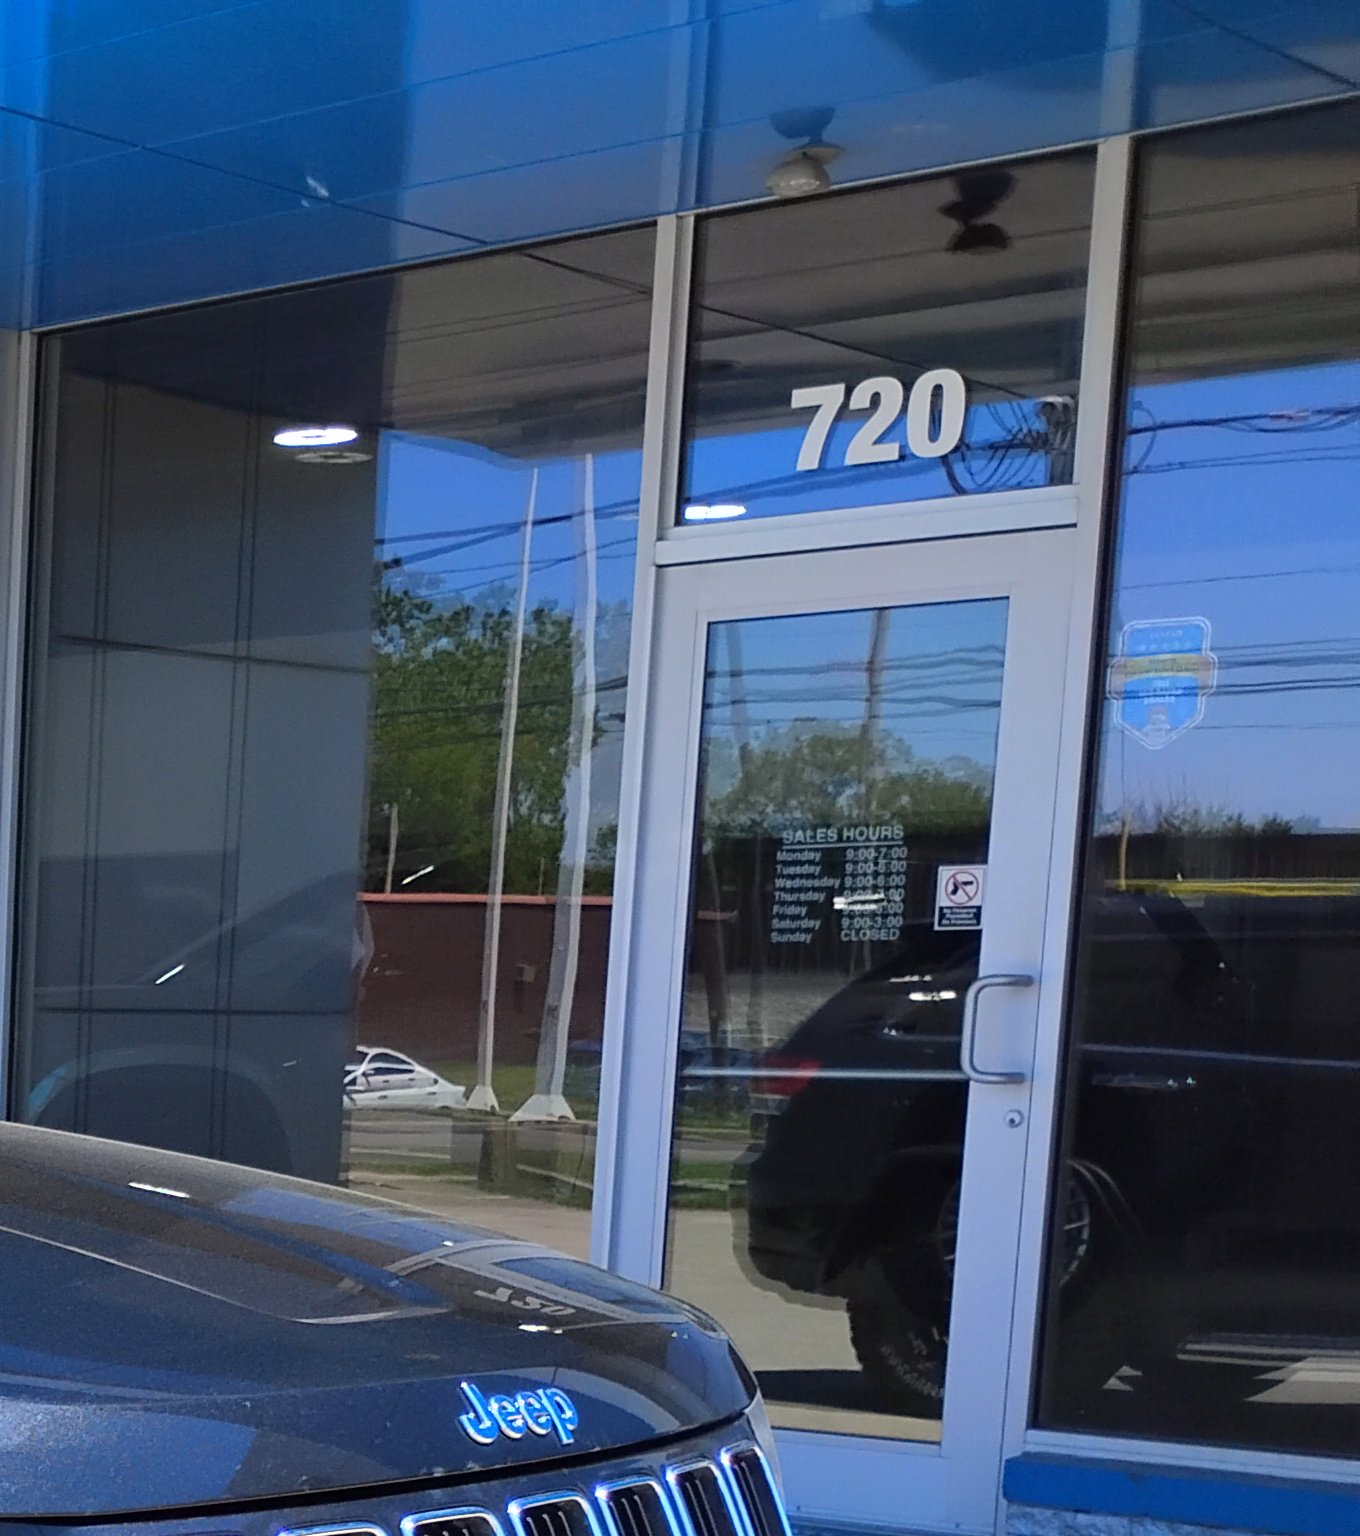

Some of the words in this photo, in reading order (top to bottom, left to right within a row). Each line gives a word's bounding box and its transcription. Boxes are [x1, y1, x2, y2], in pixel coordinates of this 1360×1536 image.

[790, 368, 966, 472] 720
[782, 828, 838, 845] SALES
[843, 825, 905, 841] HOURS
[776, 850, 822, 863] Monday
[776, 863, 822, 876] Tuesday
[774, 876, 841, 890] Wednesday
[773, 890, 826, 904] Thursday
[772, 904, 808, 918] Friday
[771, 917, 822, 931] Saturday
[770, 930, 813, 944] Sunday
[840, 929, 900, 941] CLOSED
[458, 1381, 578, 1445] Jeep
